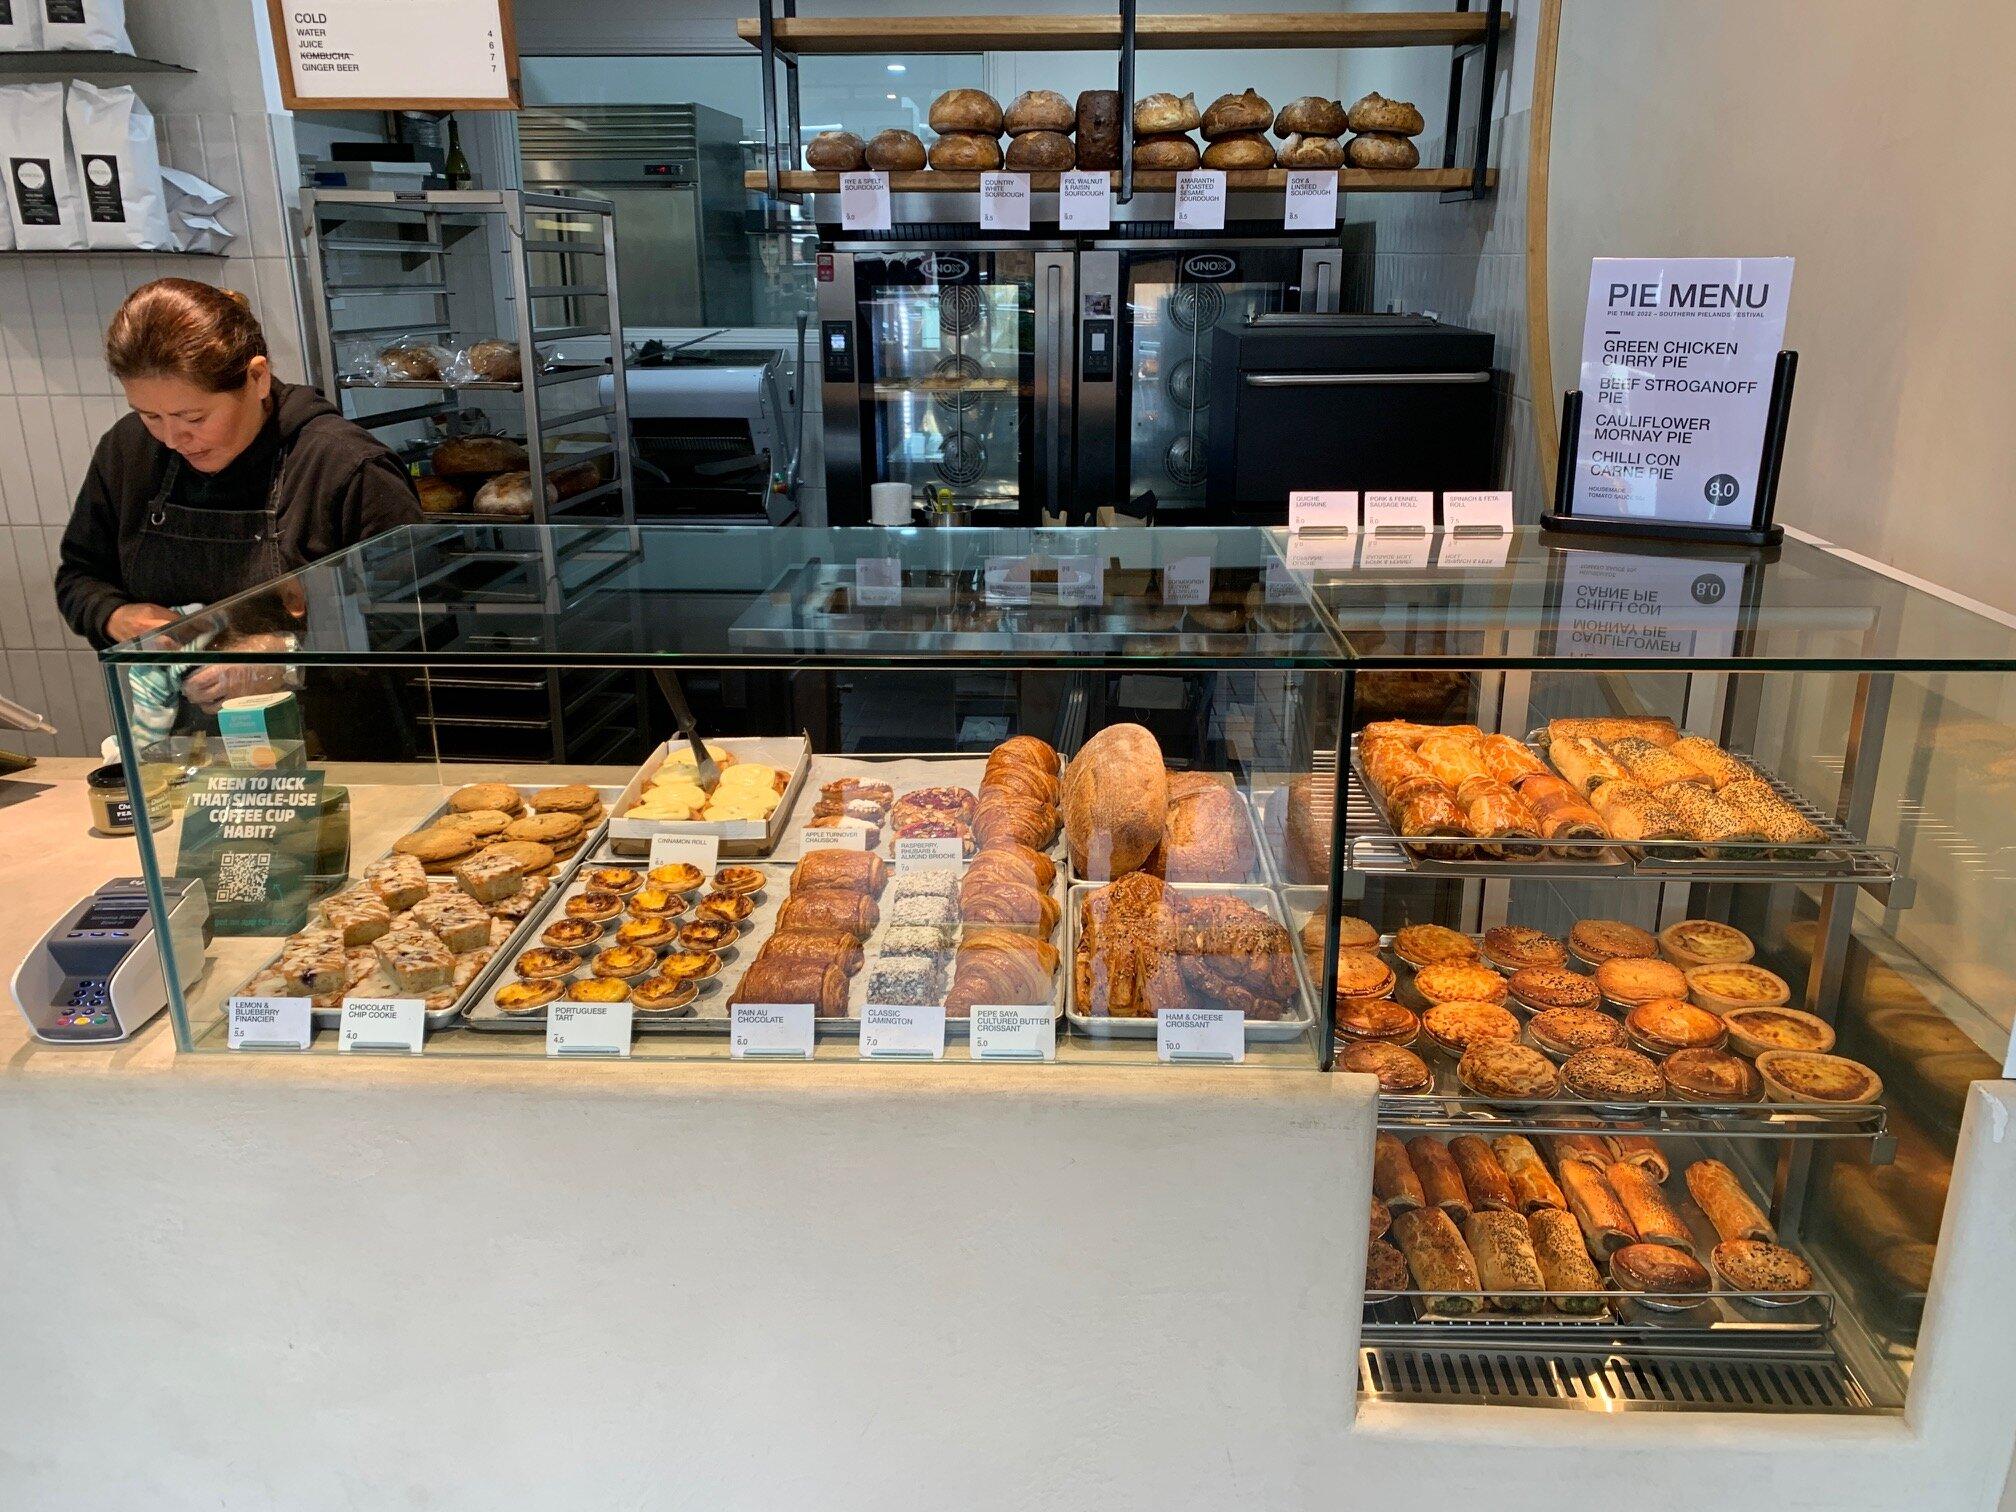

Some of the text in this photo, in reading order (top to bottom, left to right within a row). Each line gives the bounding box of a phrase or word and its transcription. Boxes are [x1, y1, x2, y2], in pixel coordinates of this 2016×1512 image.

[295, 13, 327, 24] COLD
[296, 28, 326, 37] WATER
[299, 40, 495, 49] JUICE 6
[300, 52, 495, 61] KOMBUCHA 7
[302, 63, 335, 72] GINGER
[337, 63, 360, 72] BEER
[925, 263, 961, 273] UNOX
[1190, 261, 1227, 271] UNOX
[1608, 283, 1769, 309] PIE MENU
[1604, 339, 1738, 355] GREEN CHICKEN
[1602, 354, 1688, 368] CURRY PIE
[1600, 377, 1758, 394] BEEF STROGANOFF
[1598, 391, 1623, 403] PIE
[1595, 414, 1711, 431] CAULIFLOWER
[1594, 428, 1693, 444] MORNAY PIE
[1591, 450, 1680, 467] CHILLI CON
[1590, 464, 1674, 480] CARNE PIE
[1708, 482, 1735, 498] 8.0
[207, 777, 306, 791] KEEN TO KICK
[192, 793, 318, 807] THAT SINGLE-USE
[209, 809, 296, 823] COFFEE CUP
[223, 825, 277, 839] HABIT?
[235, 1001, 262, 1009] LEMON
[349, 1003, 395, 1012] CHOCOLATE
[368, 1011, 398, 1019] COOKIE
[555, 1007, 607, 1015] PORTUGUESE
[868, 1009, 901, 1017] CLASSIC
[977, 1010, 1019, 1018] PEPE SAYA
[235, 1015, 275, 1023] FINANCIER
[737, 1016, 784, 1024] CHOCOLATE
[867, 1017, 913, 1025] LAMINGTON
[977, 1017, 1050, 1026] CULTURED BUTTER
[1192, 1013, 1224, 1021] CHEESE
[346, 1032, 358, 1040] 4.0
[553, 1036, 564, 1044] 4.5
[737, 1038, 748, 1046] 6.0
[866, 1038, 878, 1046] 7.0
[1166, 1042, 1180, 1050] 10.0
